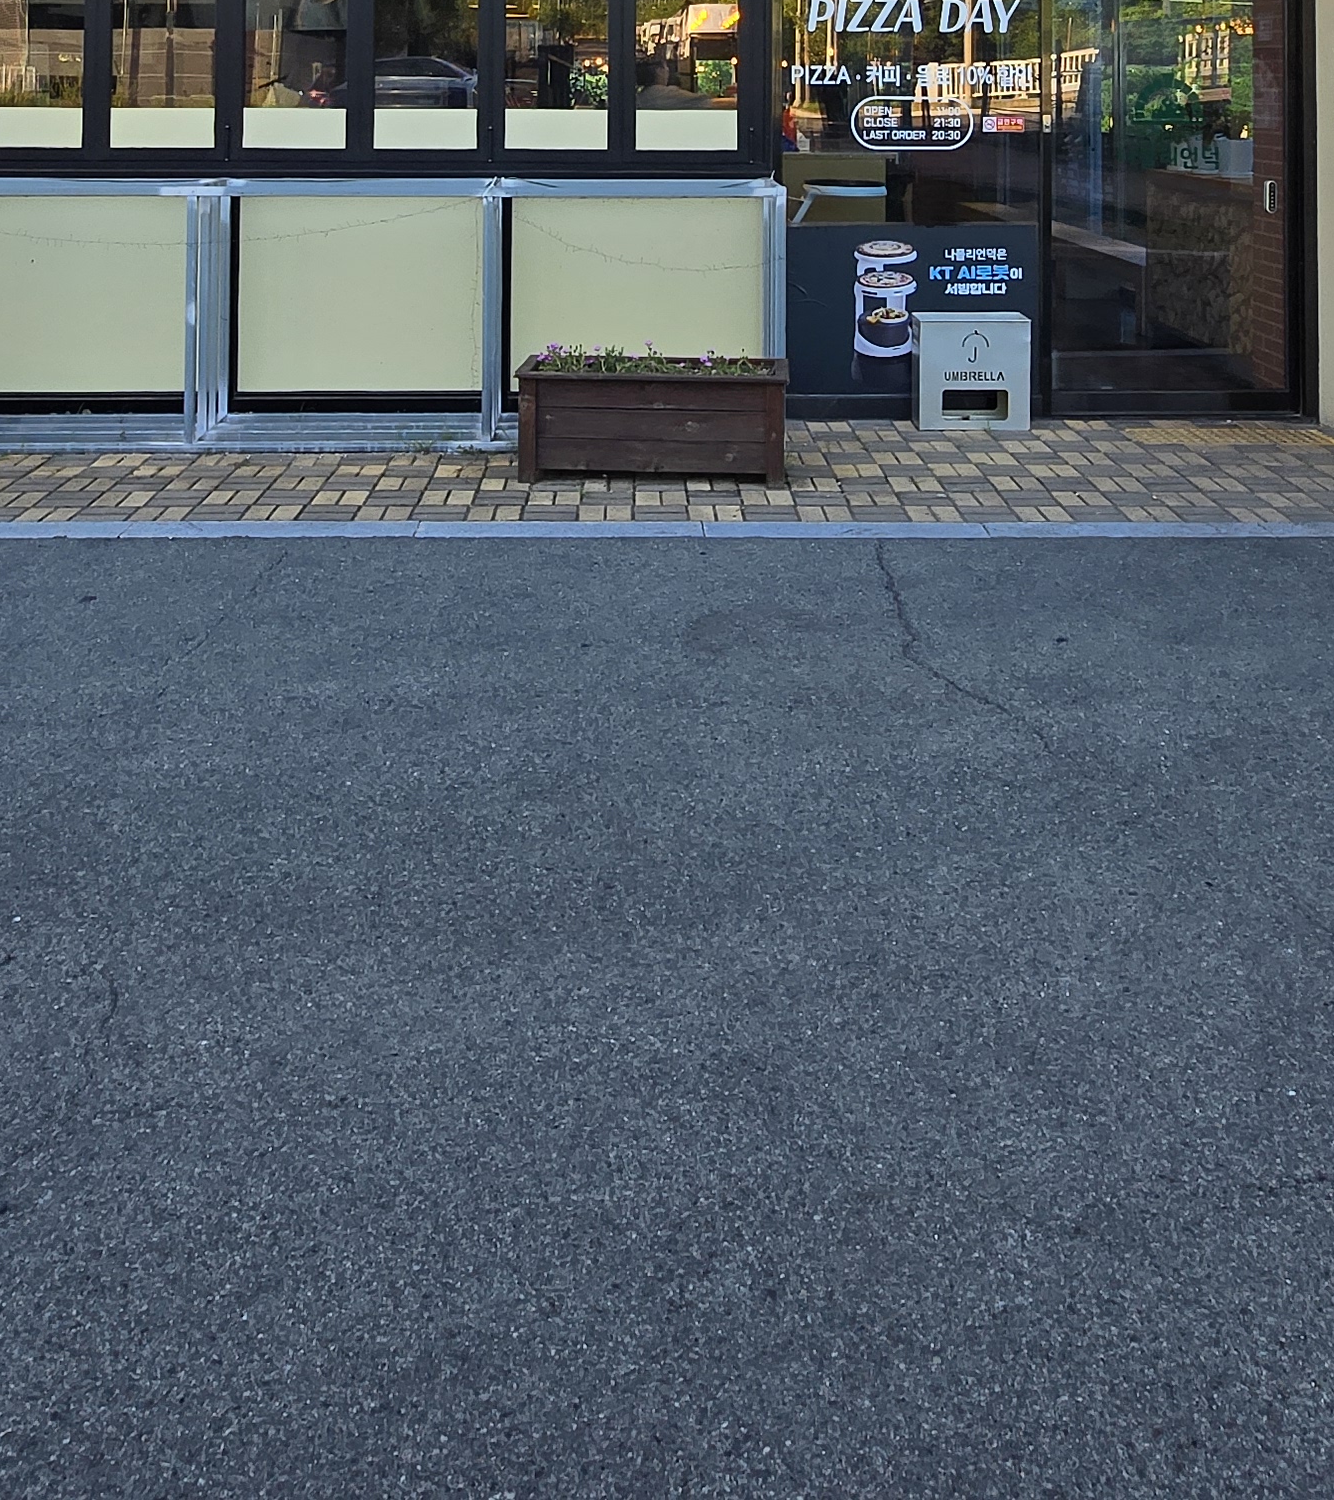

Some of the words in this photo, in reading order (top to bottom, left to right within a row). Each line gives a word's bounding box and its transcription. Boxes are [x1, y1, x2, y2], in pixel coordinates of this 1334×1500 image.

[791, 65, 851, 85] PIZZA
[866, 65, 901, 87] 커피
[957, 65, 994, 86] 10%
[864, 106, 893, 117] OPEN
[863, 117, 898, 128] CLOSE
[933, 117, 961, 128] 21:30
[863, 129, 891, 141] LAST
[892, 129, 926, 141] ORDER
[932, 130, 961, 140] 20:30
[945, 248, 1007, 261] 나폴리언덕은
[929, 266, 954, 280] KT
[957, 264, 1023, 280] AI로봇이
[945, 282, 1007, 295] 서빙합니다
[944, 371, 1005, 382] UMBRELLA
